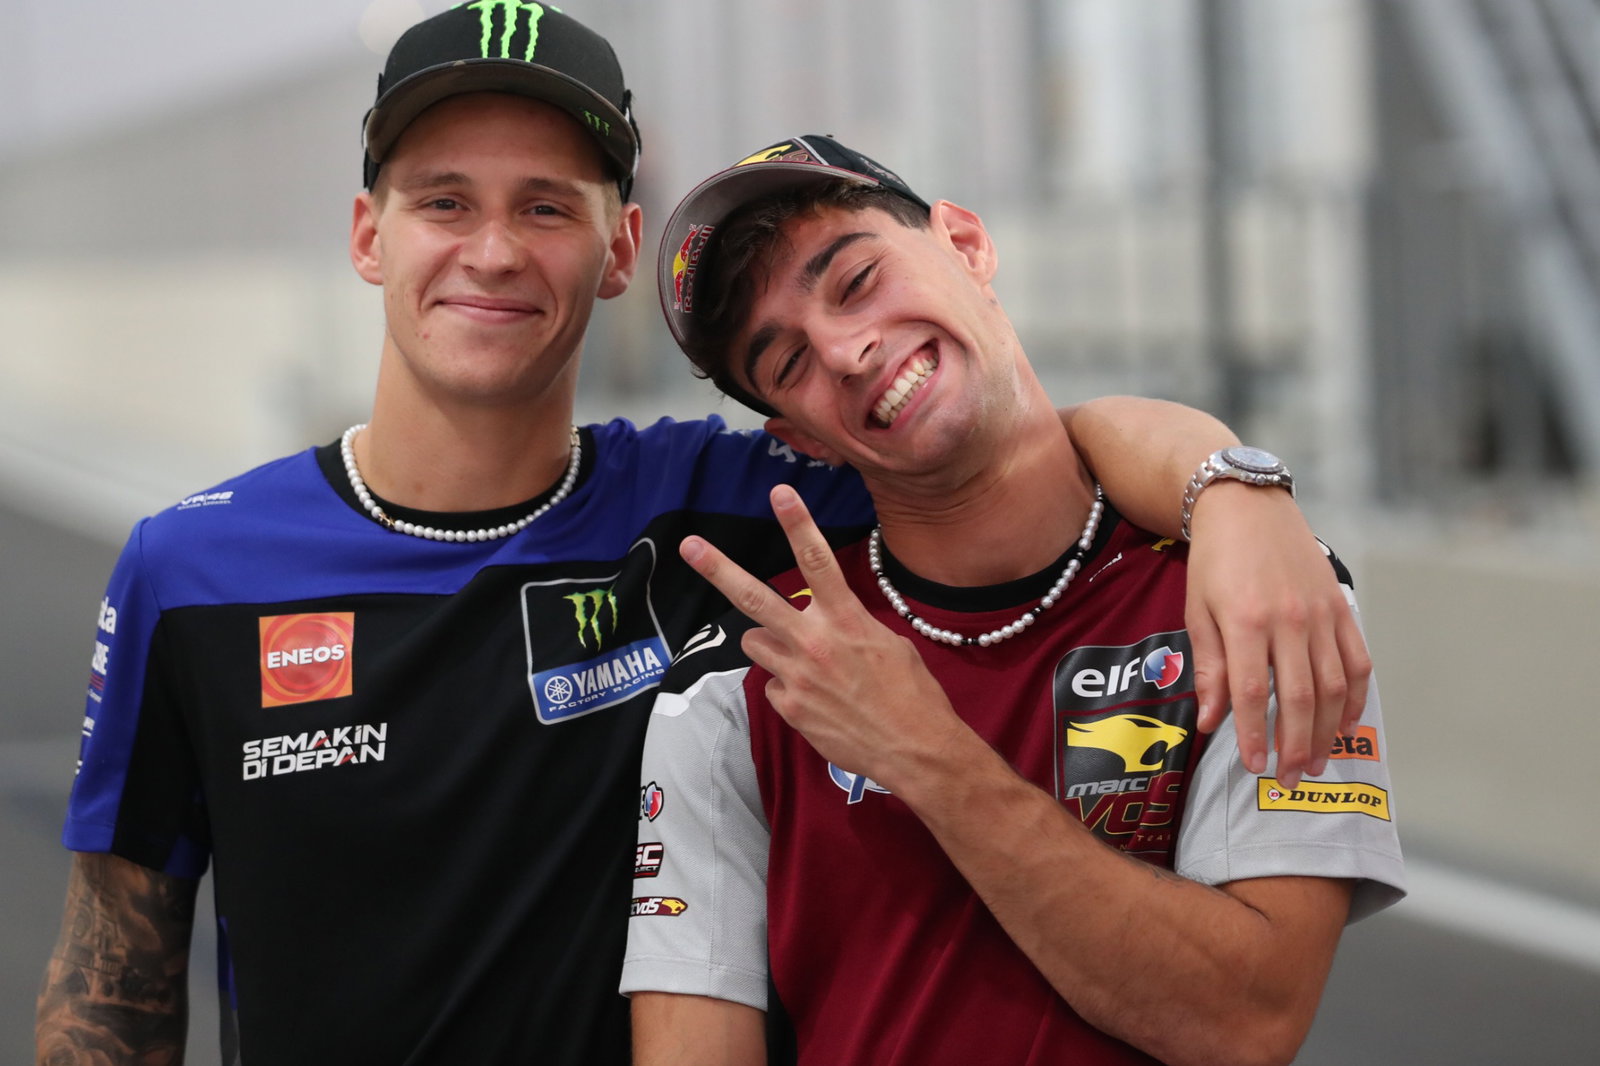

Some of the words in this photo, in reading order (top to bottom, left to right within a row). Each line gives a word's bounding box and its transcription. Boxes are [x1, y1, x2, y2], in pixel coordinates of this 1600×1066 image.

[689, 225, 715, 266] Bull
[684, 267, 697, 313] Red
[98, 596, 117, 634] ta
[267, 644, 345, 669] ENEOS
[572, 646, 663, 697] YAMAHA
[548, 691, 606, 712] FACTORY
[613, 668, 665, 692] RACING
[1071, 656, 1141, 698] elf
[272, 742, 386, 776] DEPAN
[1330, 735, 1373, 756] eta
[1066, 777, 1148, 798] marc
[1288, 790, 1382, 808] DUNLOP
